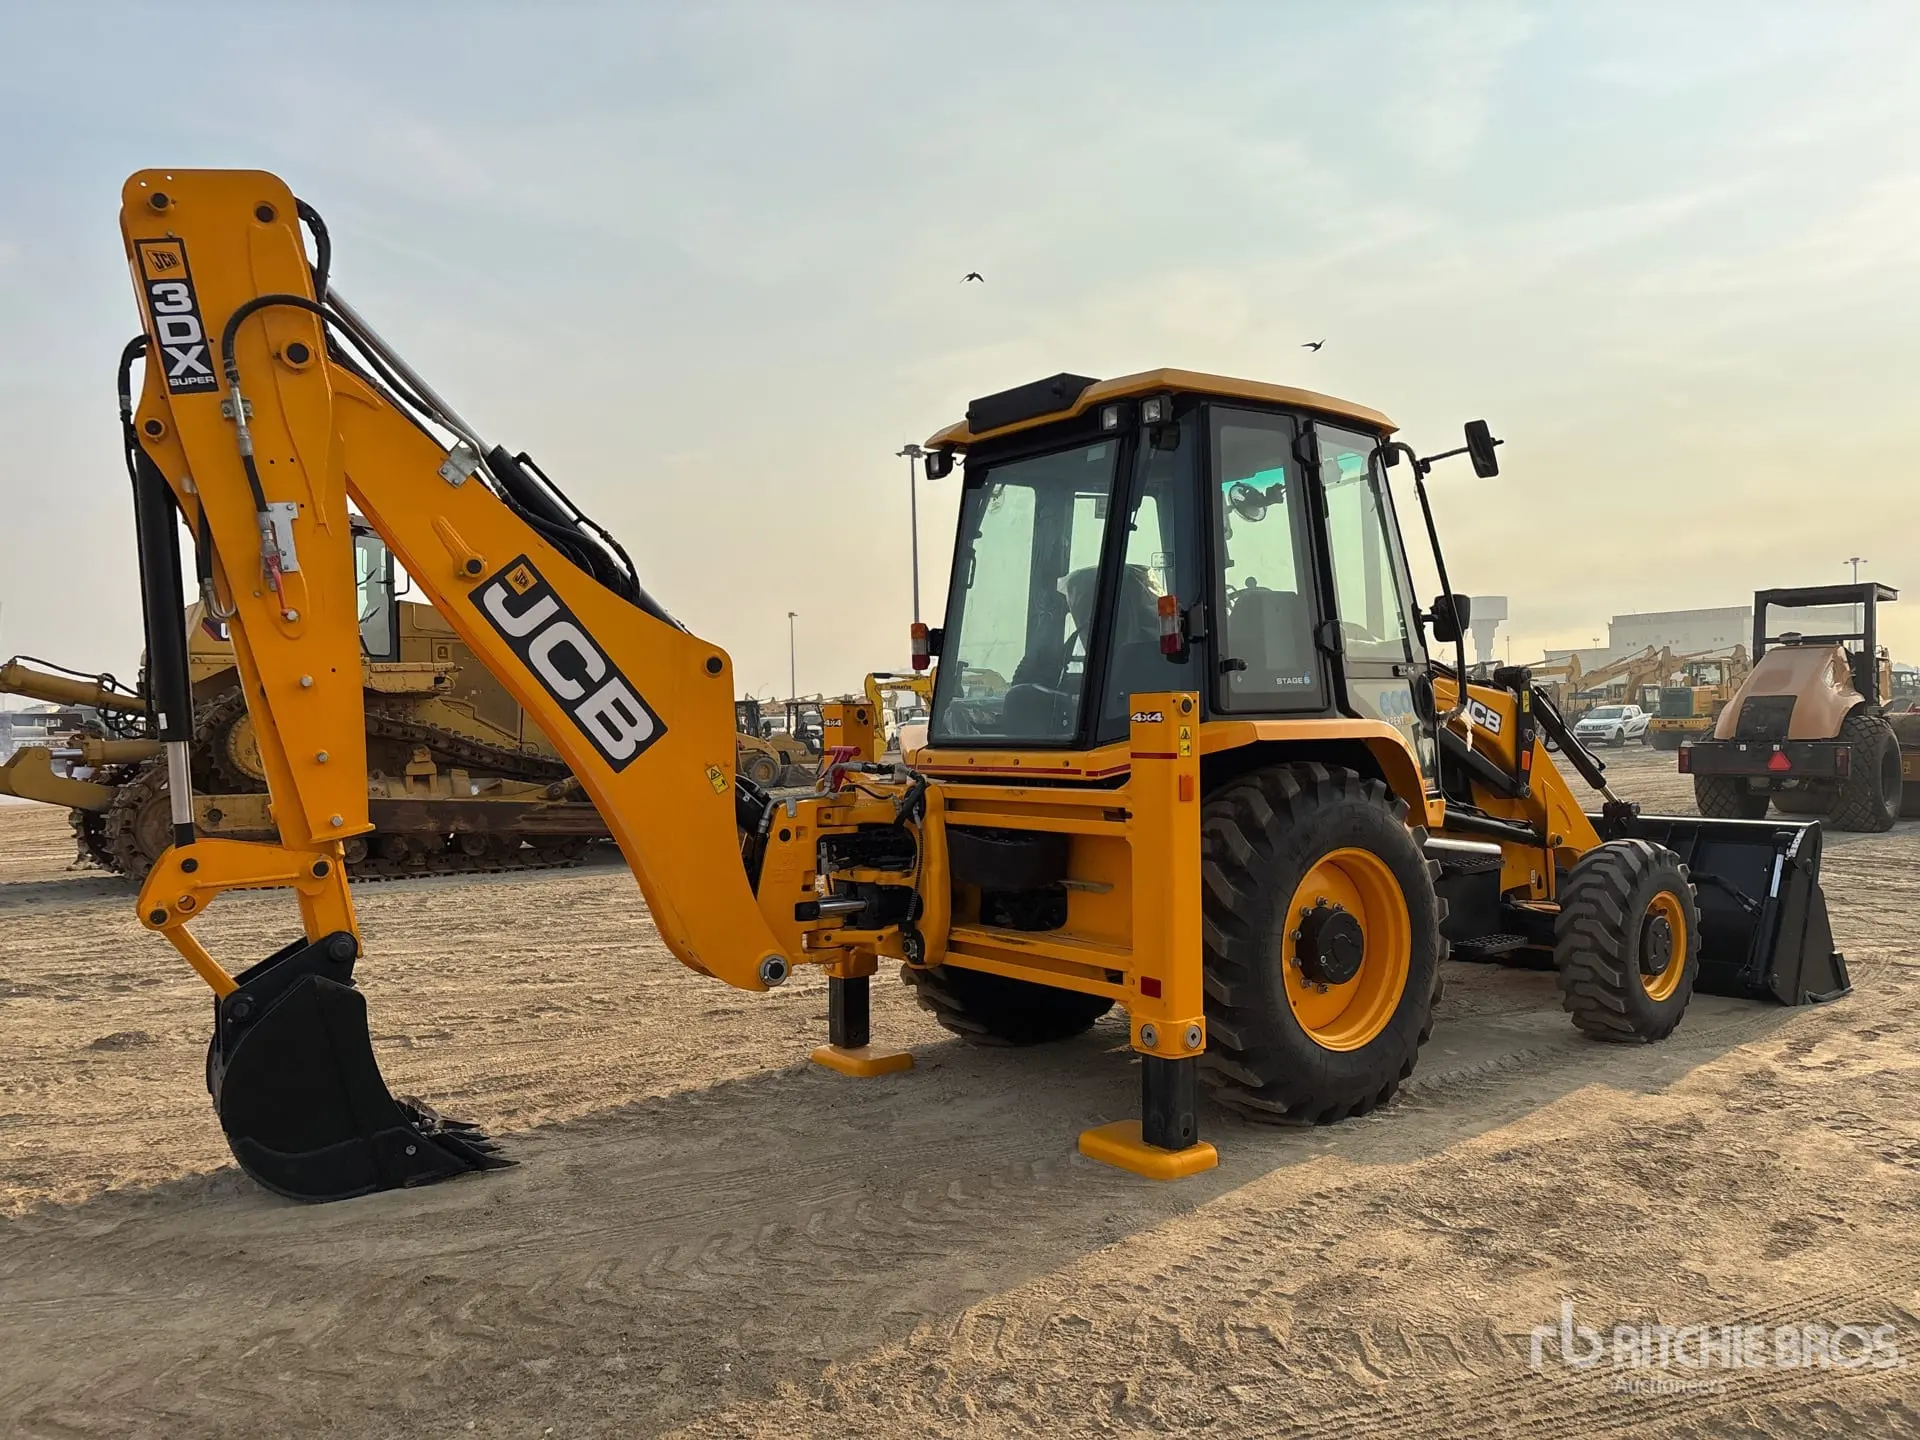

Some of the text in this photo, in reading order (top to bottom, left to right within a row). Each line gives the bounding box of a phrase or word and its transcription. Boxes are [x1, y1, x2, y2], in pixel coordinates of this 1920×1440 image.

[152, 252, 177, 270] JCB
[151, 282, 213, 376] 3DX
[169, 376, 216, 386] SUPER
[483, 582, 654, 760] JCB
[1276, 677, 1303, 685] STAGE
